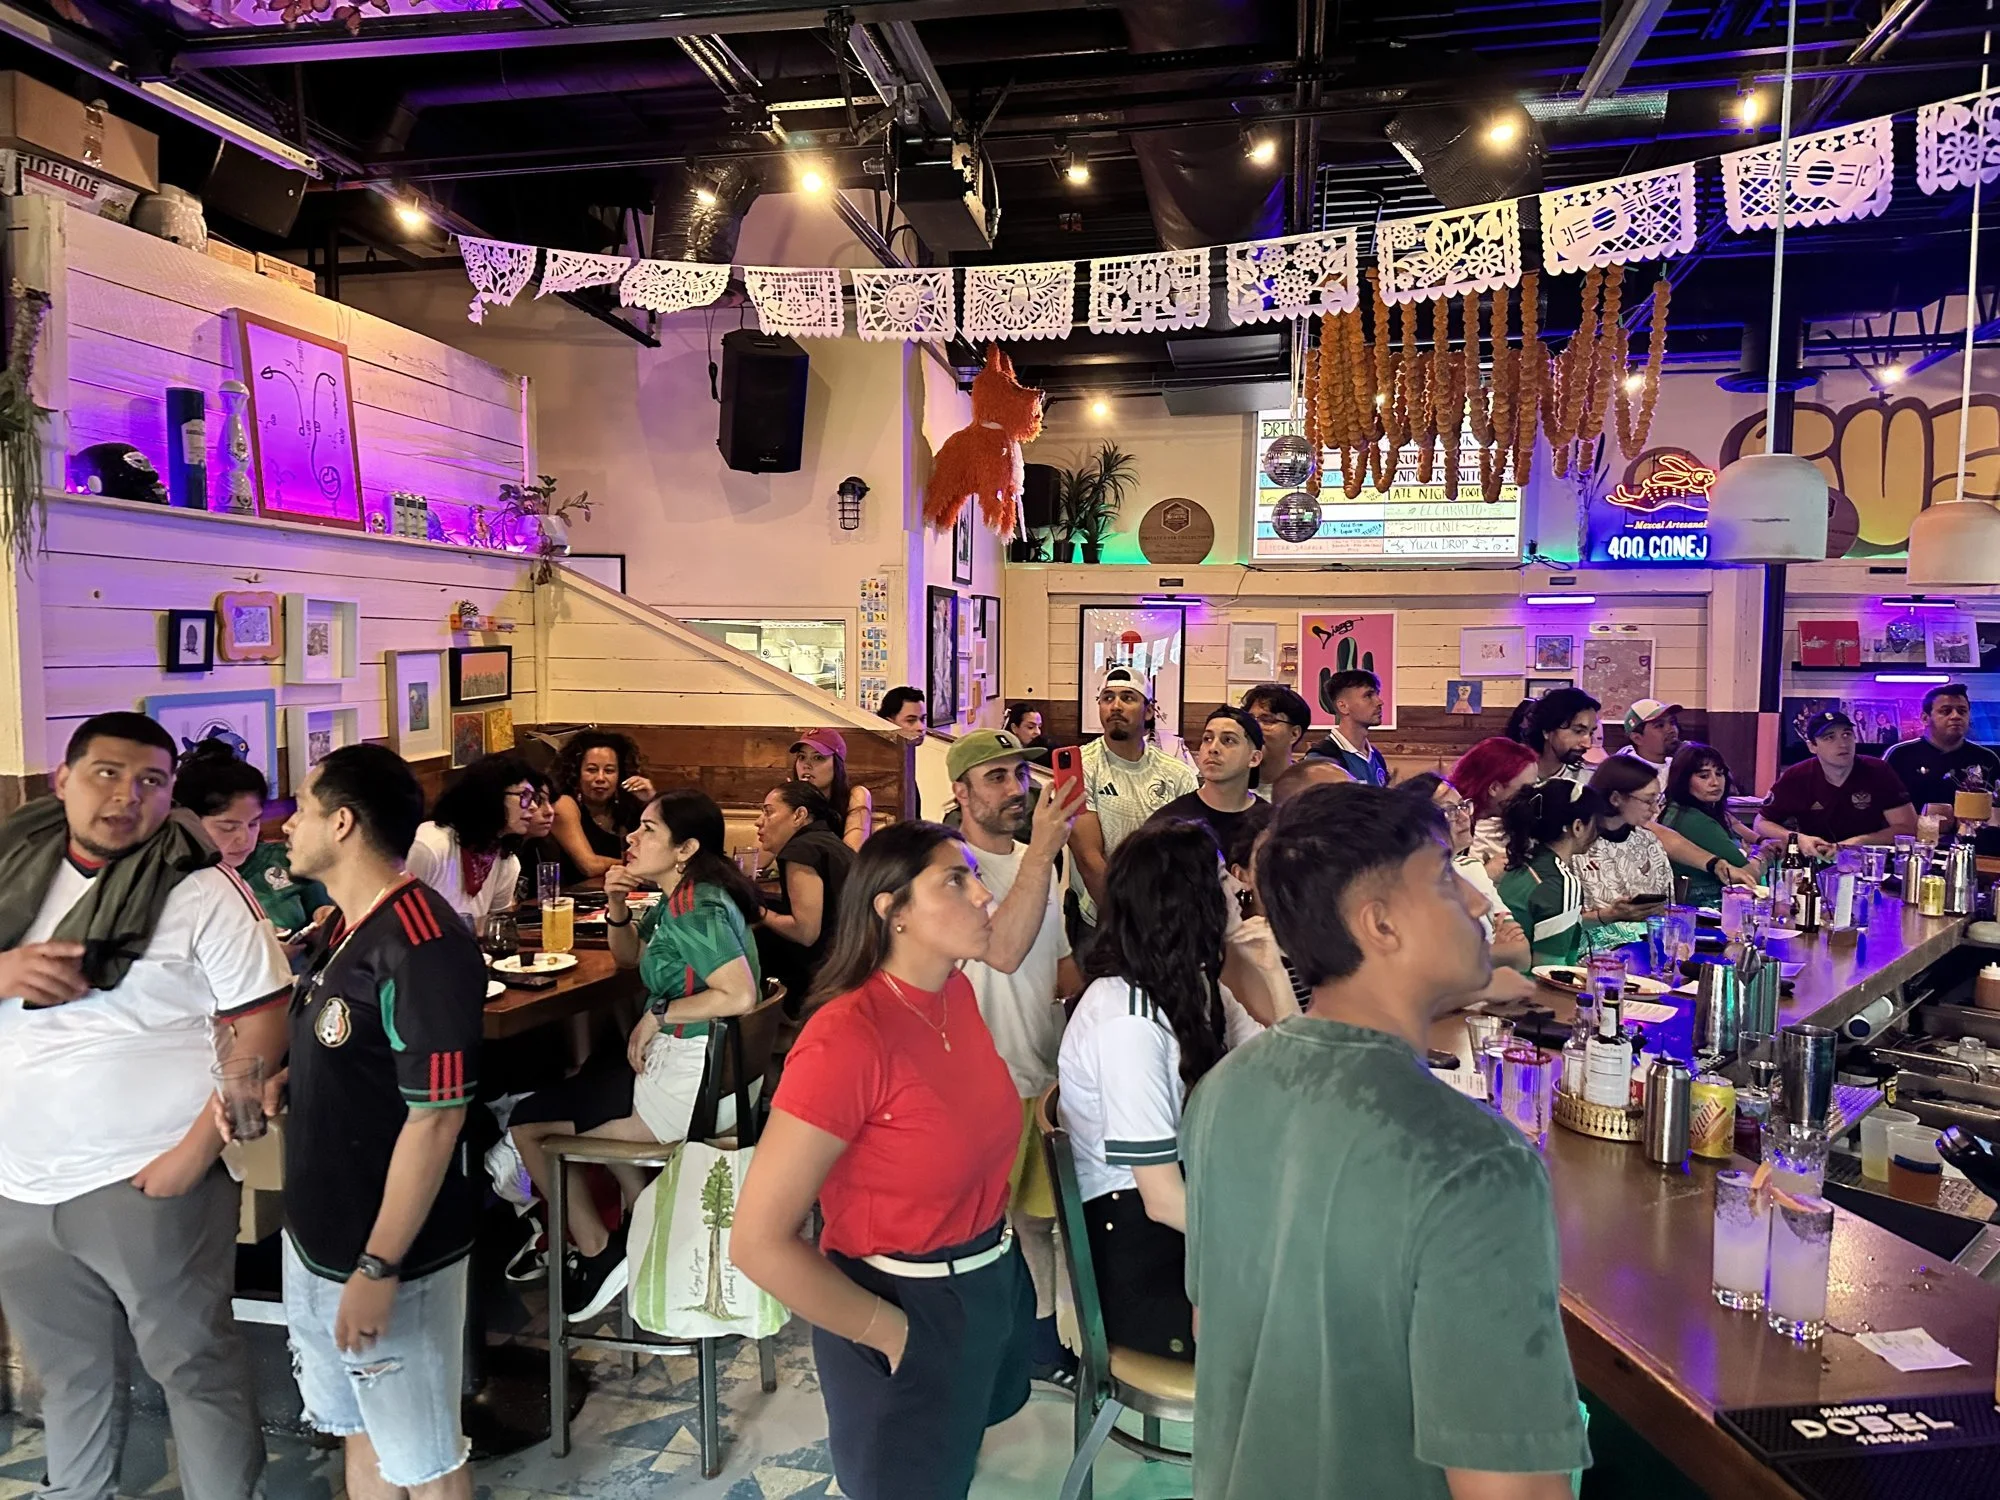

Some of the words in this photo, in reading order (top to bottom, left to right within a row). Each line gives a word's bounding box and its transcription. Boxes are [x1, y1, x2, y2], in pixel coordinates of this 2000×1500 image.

[1634, 521, 1666, 530] Mezcal
[1665, 520, 1709, 530] Artesanal
[1608, 536, 1645, 560] 400
[1791, 1412, 1955, 1439] DOBEL
